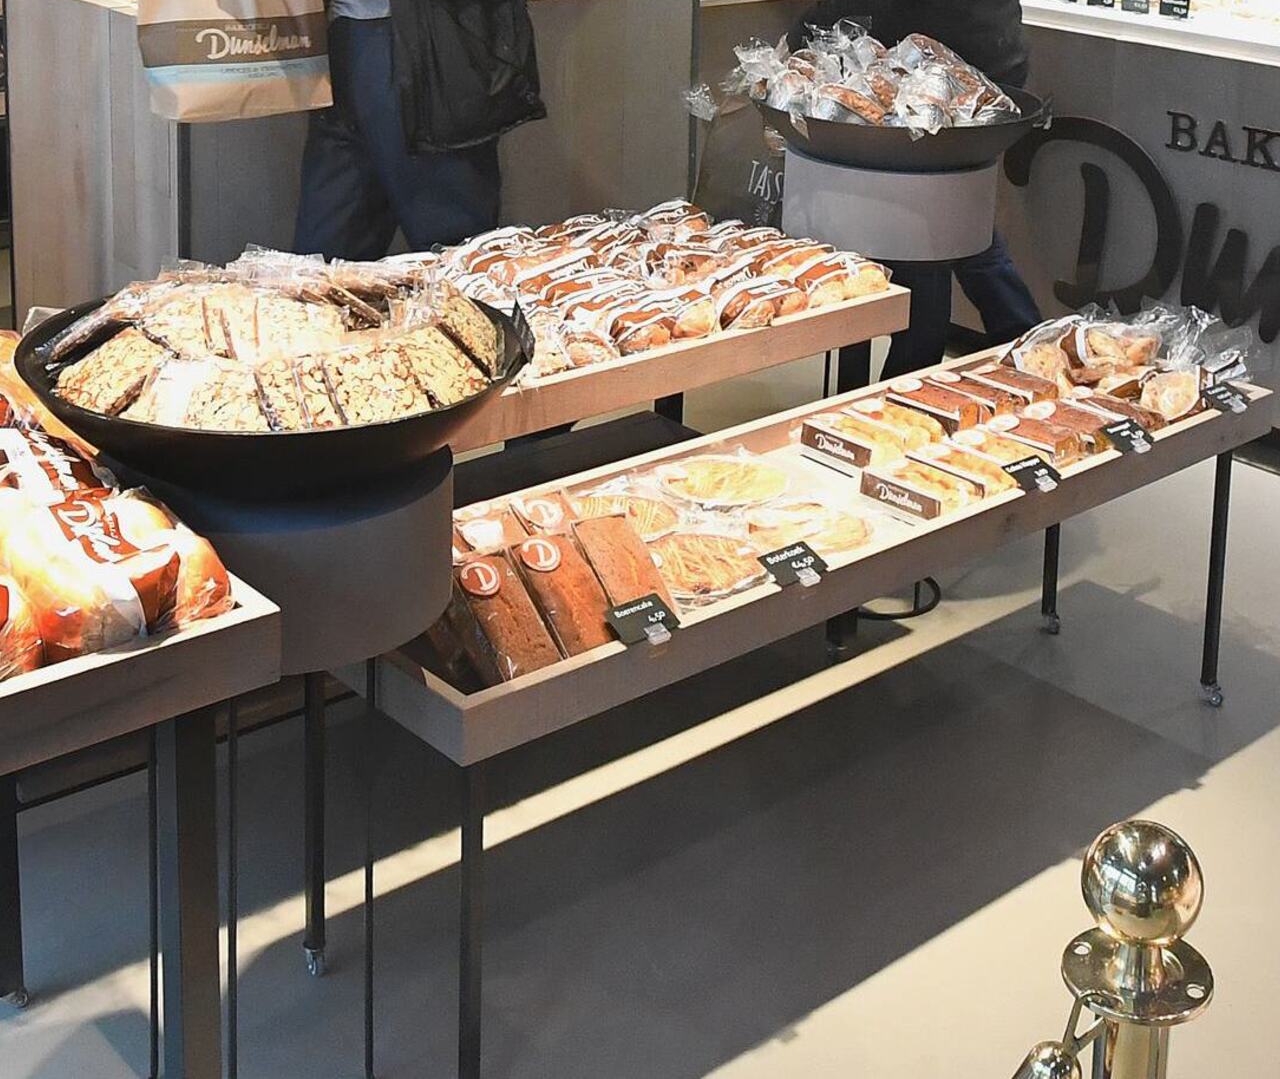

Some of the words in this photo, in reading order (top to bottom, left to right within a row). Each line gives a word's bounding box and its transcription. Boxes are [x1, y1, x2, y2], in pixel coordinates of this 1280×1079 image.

[195, 24, 312, 60] Dunselman
[523, 538, 561, 569] D
[766, 546, 806, 565] Boterkoek
[462, 561, 499, 595] D
[613, 600, 654, 618] Boerencake
